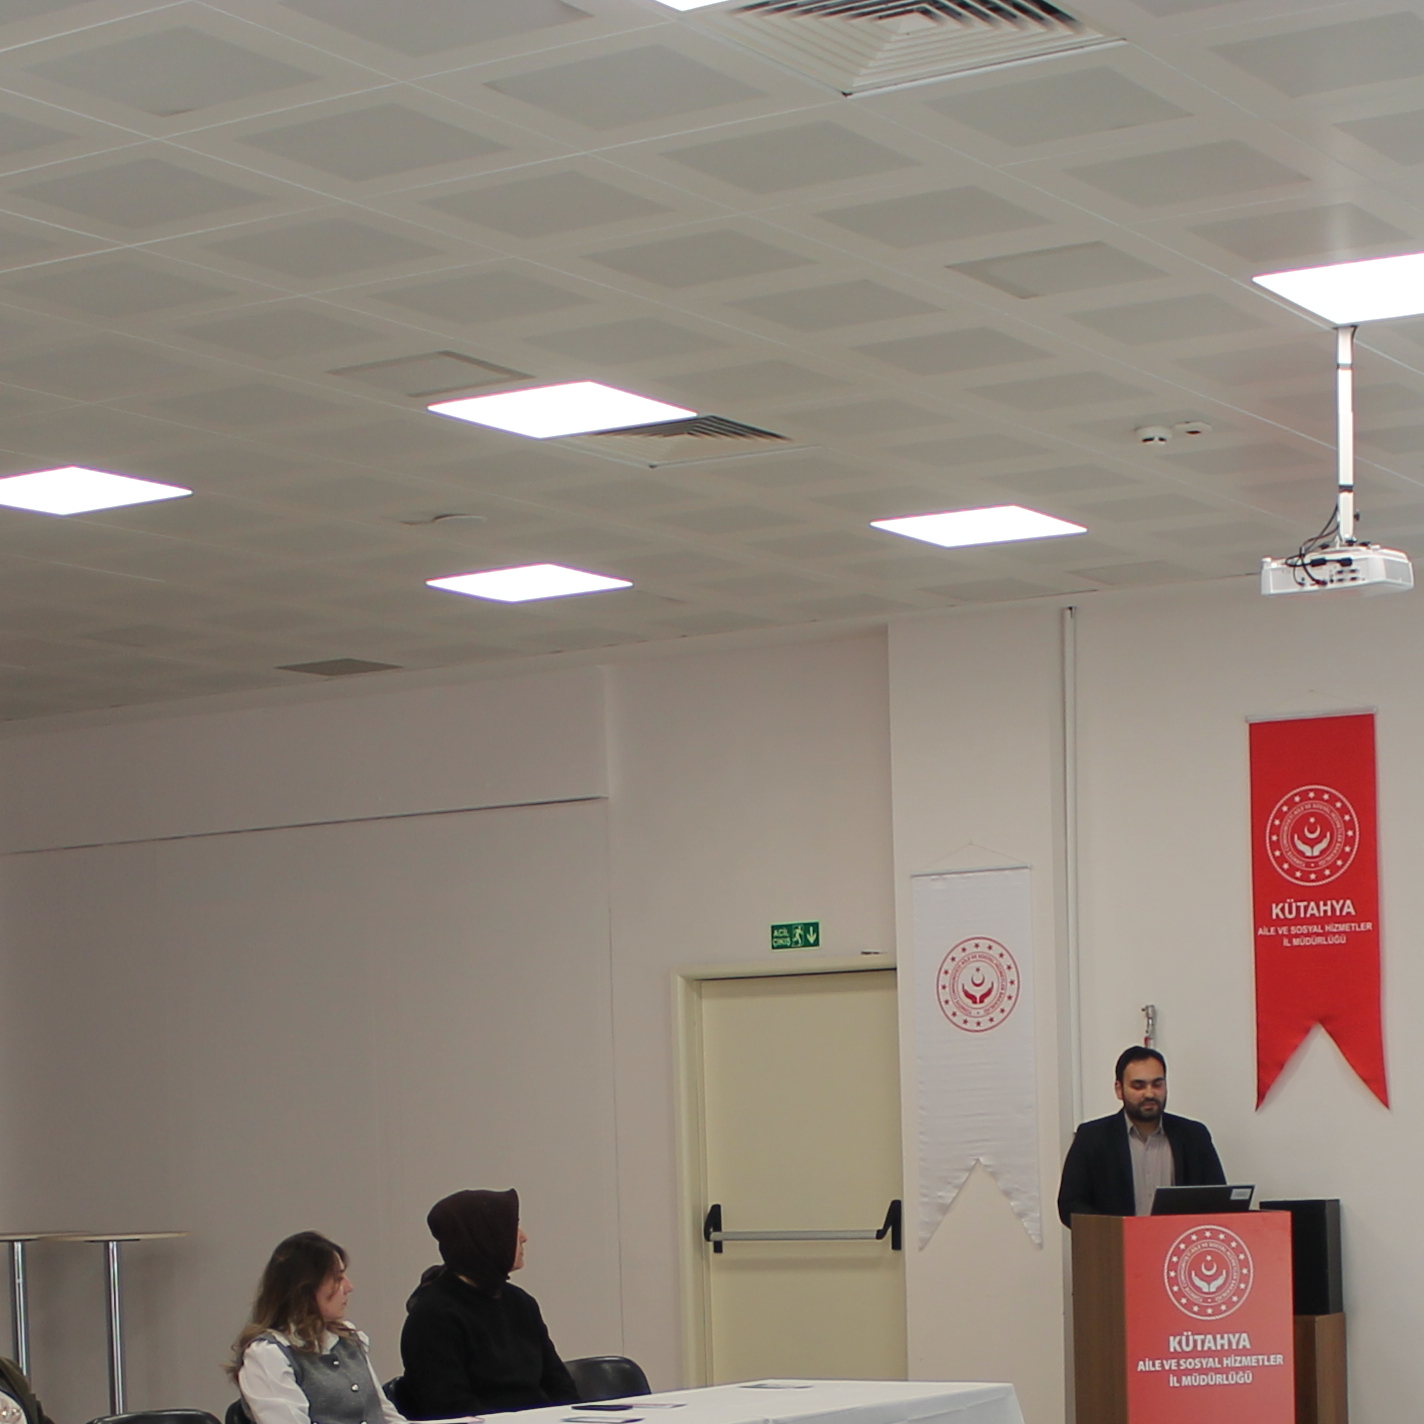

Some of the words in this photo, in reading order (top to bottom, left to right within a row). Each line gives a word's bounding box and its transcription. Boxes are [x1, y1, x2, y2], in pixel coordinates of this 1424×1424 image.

[1272, 899, 1356, 920] KÜTAHYA
[1258, 925, 1276, 936] AİLE
[1278, 925, 1289, 935] VE
[1290, 924, 1323, 934] SOSYAL
[1325, 921, 1372, 932] HİZMETLER
[1169, 1331, 1251, 1352] KÜTAHYA
[1137, 1358, 1162, 1371] AİLE
[1163, 1358, 1178, 1370] VE
[1180, 1357, 1221, 1369] SOSYAL
[1223, 1354, 1284, 1368] HİZMETLER
[1169, 1374, 1180, 1387] İL
[1182, 1371, 1253, 1386] MÜDÜRLÜĞÜ
